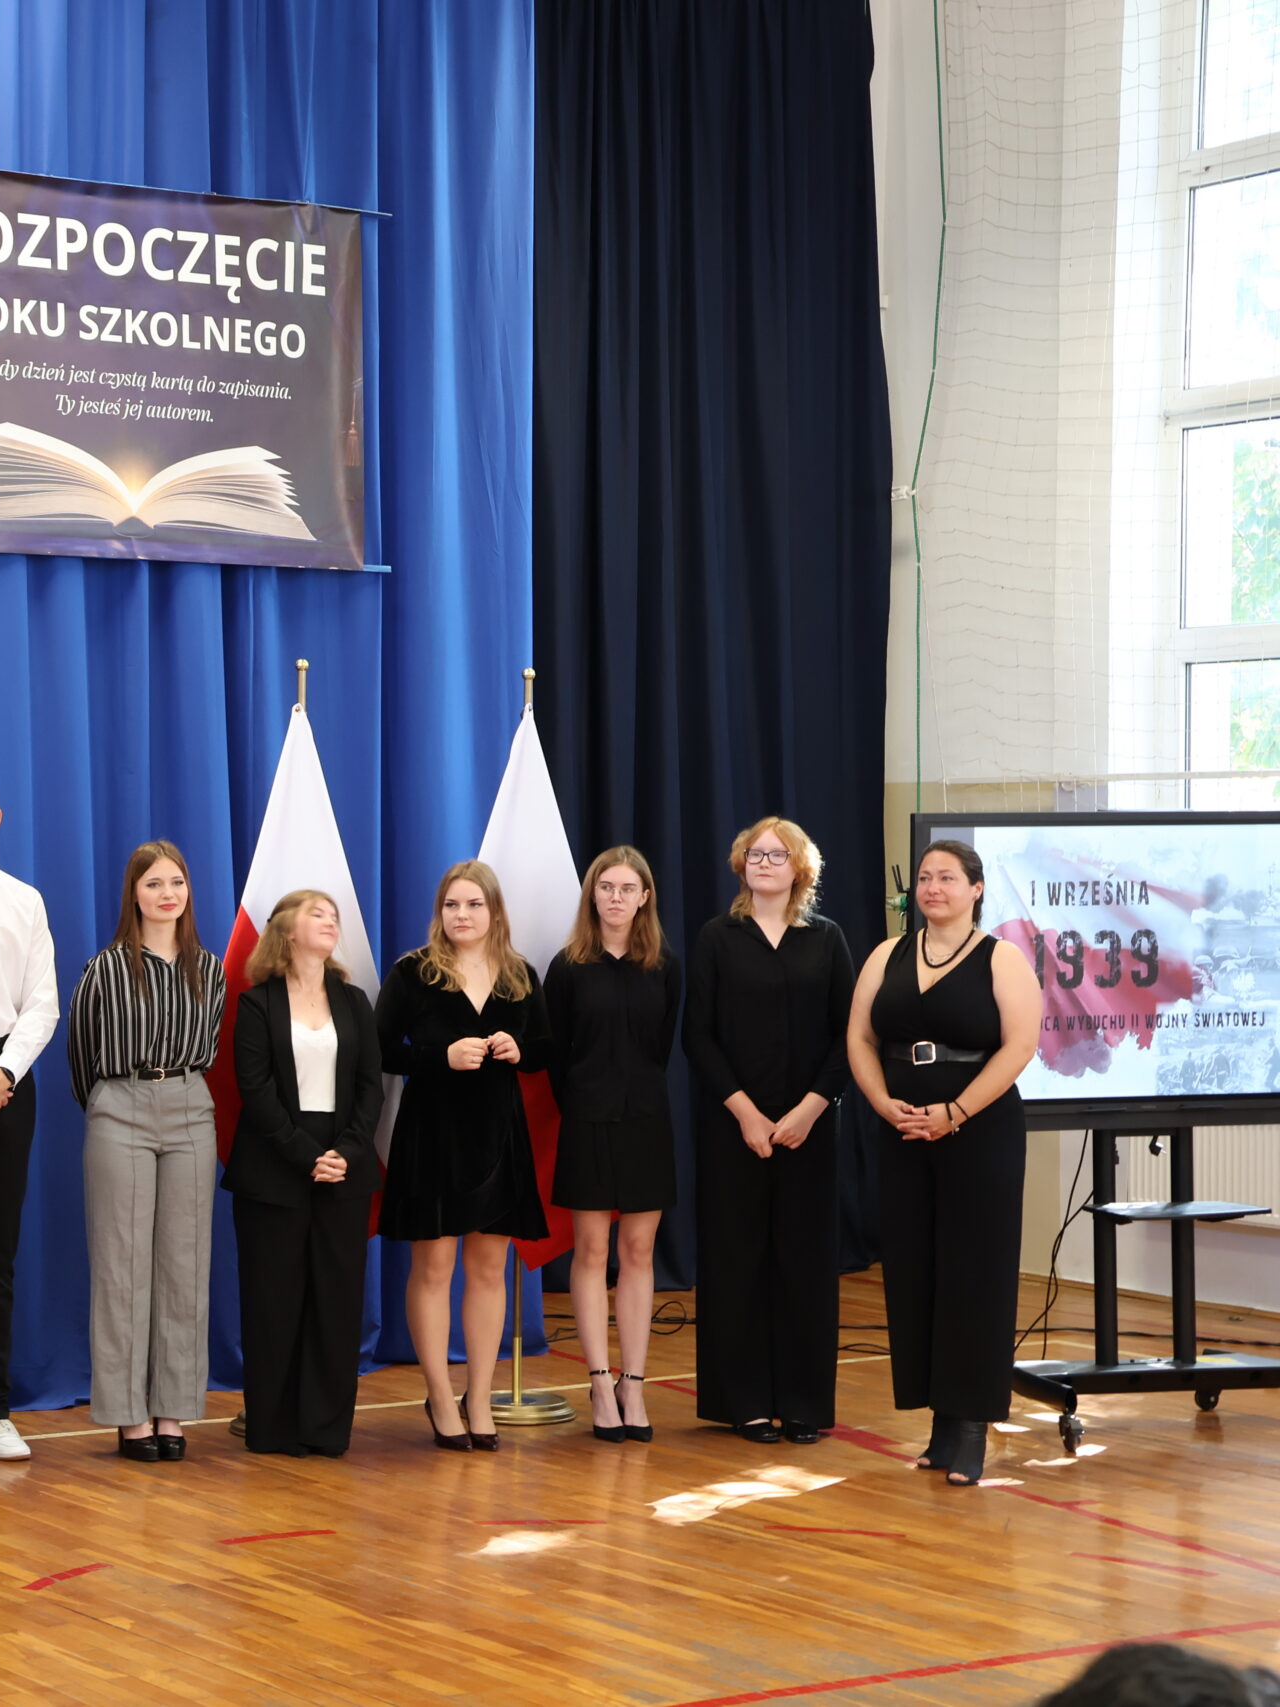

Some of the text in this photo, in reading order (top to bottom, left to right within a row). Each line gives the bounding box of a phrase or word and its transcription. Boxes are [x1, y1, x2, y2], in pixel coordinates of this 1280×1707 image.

[78, 304, 306, 358] SZKOLNEGO
[22, 361, 65, 381] dzień
[66, 364, 97, 386] jest
[98, 371, 147, 391] czystą
[150, 371, 194, 395] kartą
[196, 375, 216, 393] do
[218, 379, 292, 400] zapisania.
[55, 394, 214, 422] Ty jesteś jej autorem.
[1047, 873, 1150, 906] WRZEŚNIA
[1031, 929, 1159, 990] 1939
[1066, 1014, 1126, 1031] WYBUCHU
[1131, 1013, 1139, 1028] II
[1144, 1013, 1188, 1029] WOJNY
[1194, 1009, 1265, 1028] ŚWIATOWEJ
